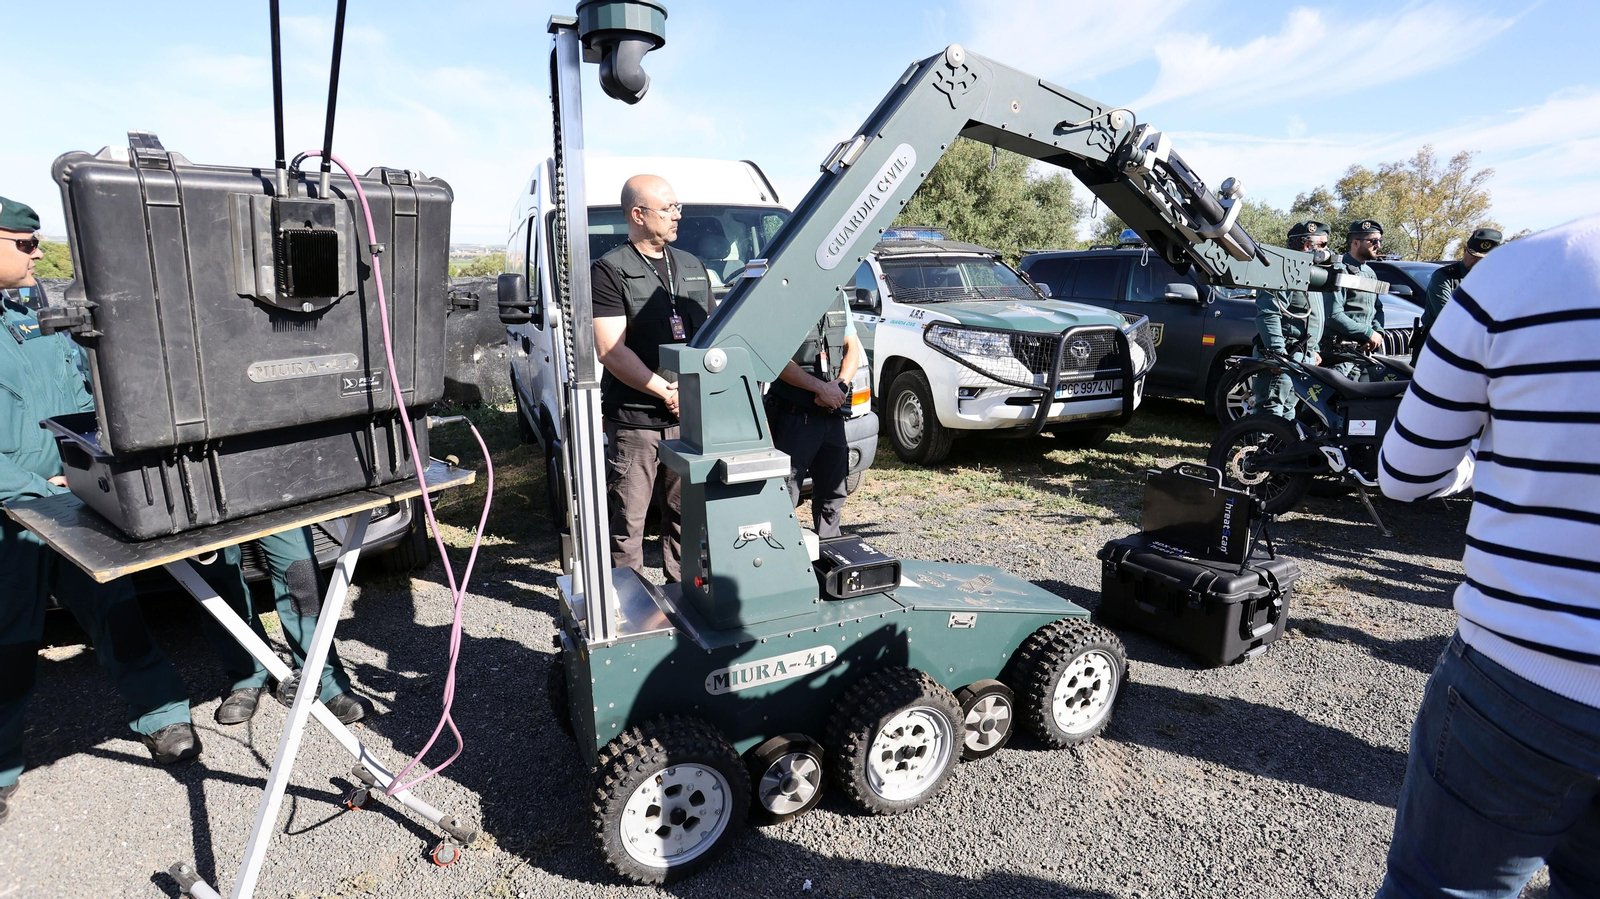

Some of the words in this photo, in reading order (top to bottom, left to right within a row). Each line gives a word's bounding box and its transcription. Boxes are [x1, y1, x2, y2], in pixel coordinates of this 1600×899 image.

[828, 193, 880, 256] GUARDIA
[877, 159, 908, 193] CIVIL
[255, 357, 352, 379] MIURA-41
[1220, 497, 1235, 553] ThreatScan
[713, 651, 828, 691] MIURA-41
